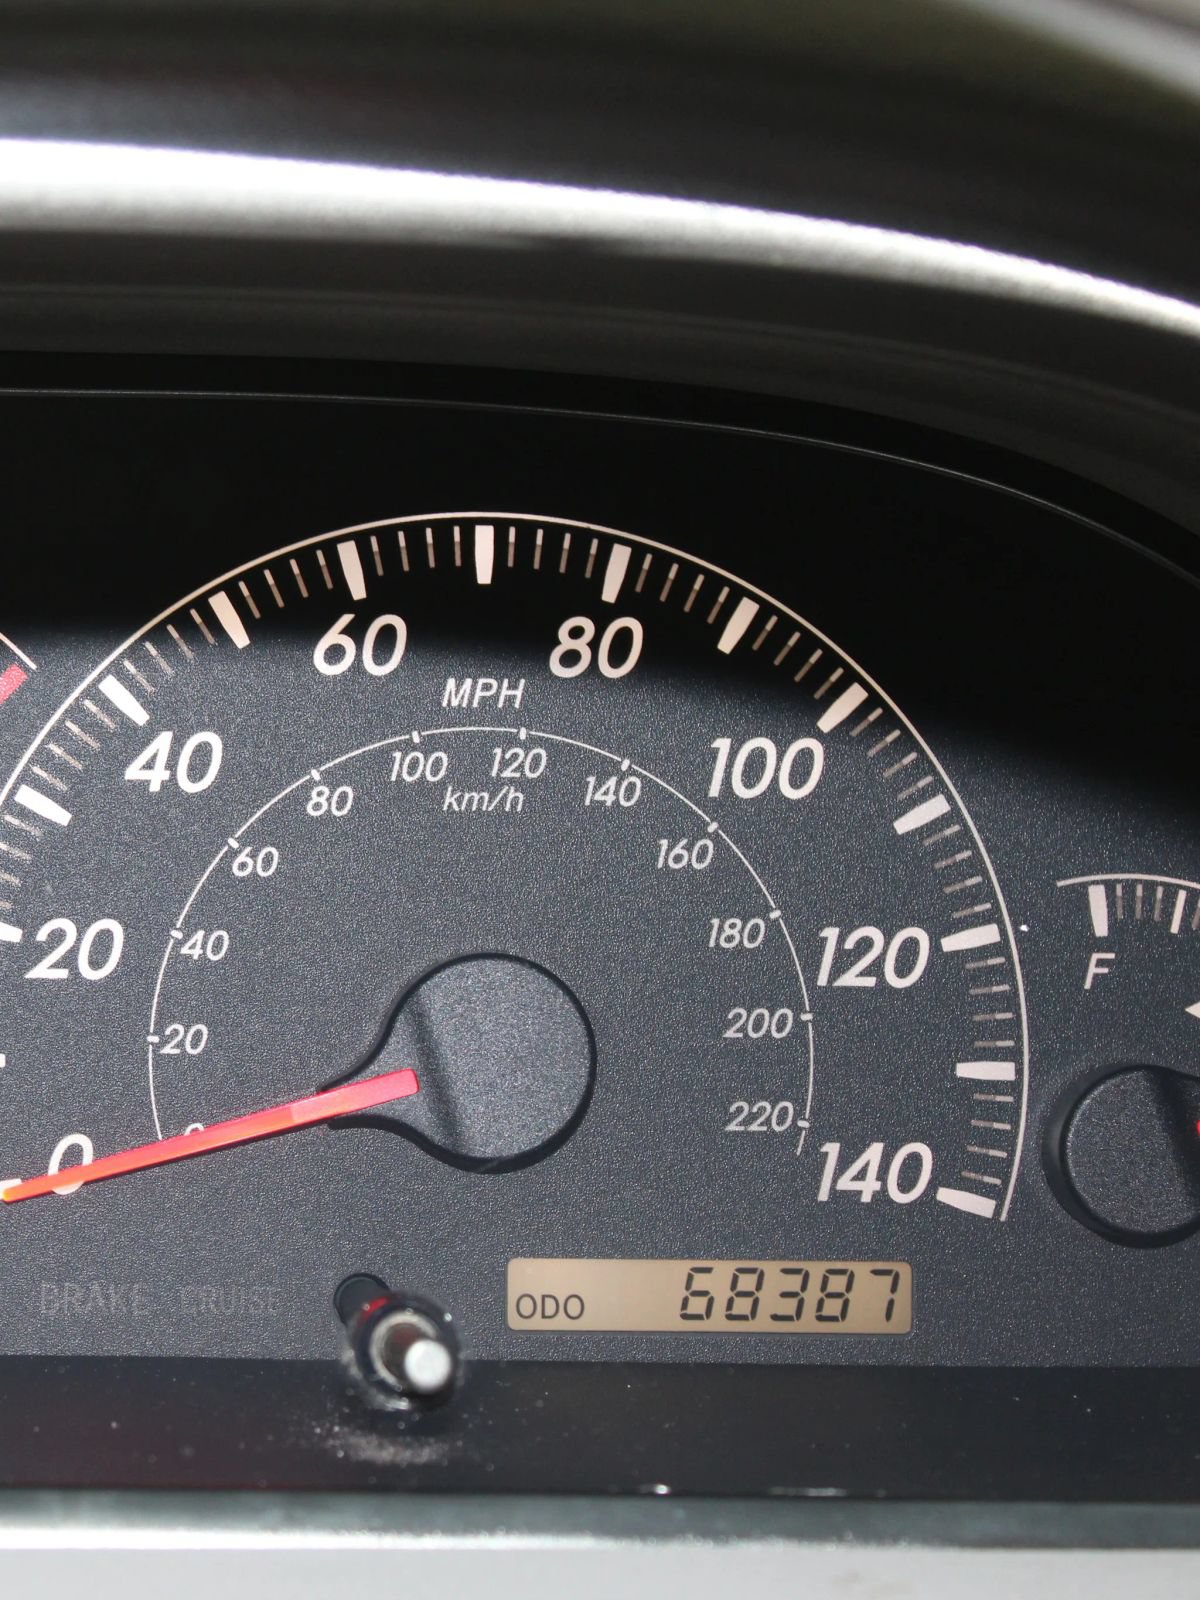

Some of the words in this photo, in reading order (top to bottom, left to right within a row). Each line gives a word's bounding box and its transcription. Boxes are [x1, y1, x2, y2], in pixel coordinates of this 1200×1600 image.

[313, 614, 406, 677] 60
[549, 616, 643, 679] 80
[442, 677, 525, 709] MPH
[124, 731, 223, 794] 40
[391, 751, 448, 782] 100
[491, 747, 547, 779] 120
[708, 737, 824, 800] 100
[306, 785, 354, 817] 80
[442, 785, 524, 812] km/h
[585, 776, 642, 807] 140
[232, 846, 279, 877] 60
[657, 839, 714, 870] 160
[24, 917, 124, 981] 20
[180, 930, 229, 961] 40
[709, 918, 765, 949] 180
[817, 926, 930, 989] 120
[1083, 952, 1116, 990] F
[160, 1023, 209, 1055] 20
[723, 1007, 793, 1039] 200
[725, 1101, 794, 1132] 220
[817, 1142, 933, 1204] 140
[40, 1280, 150, 1316] BRAKE
[180, 1282, 278, 1316] CRUISE
[515, 1294, 585, 1320] ODO
[679, 1266, 900, 1323] 68387
